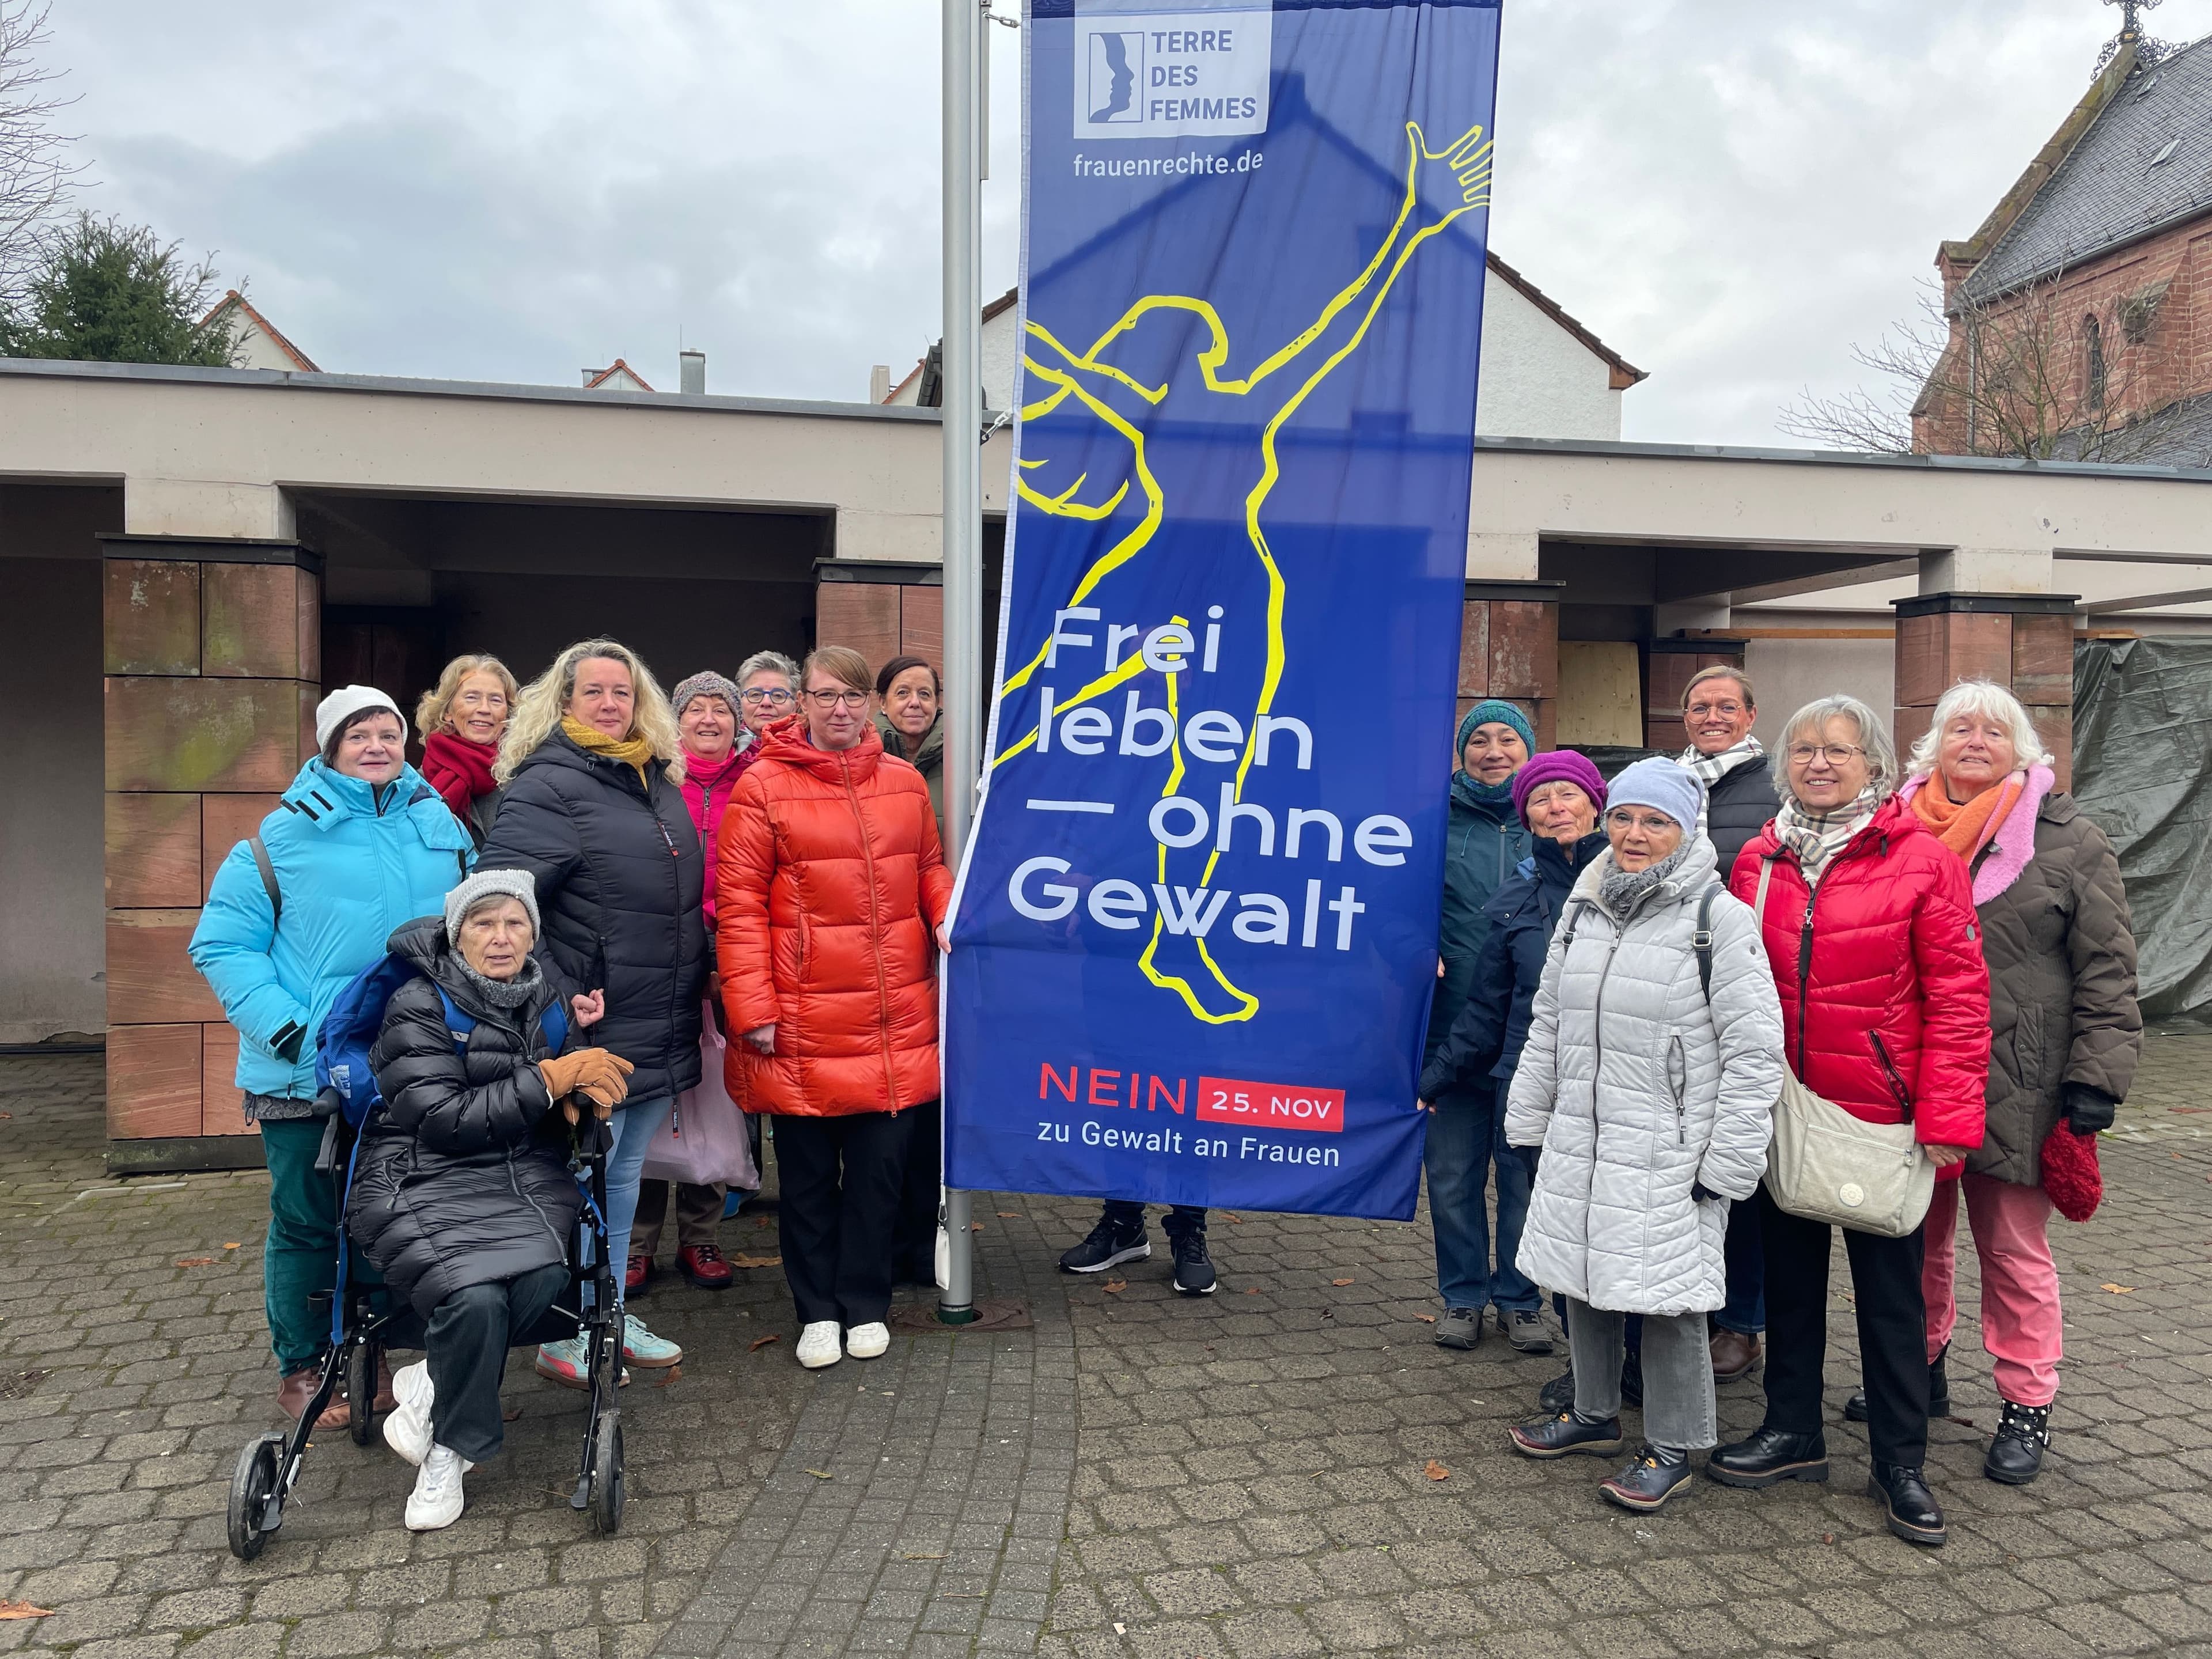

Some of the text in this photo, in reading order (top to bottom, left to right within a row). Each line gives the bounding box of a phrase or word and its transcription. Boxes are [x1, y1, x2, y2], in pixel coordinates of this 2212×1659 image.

[1151, 29, 1232, 54] TERRE
[1152, 65, 1198, 88] DES
[1150, 97, 1256, 121] FEMMES
[1073, 150, 1263, 176] frauenrechte.de
[1044, 604, 1224, 673] Frei
[1036, 687, 1313, 770] leben
[1149, 782, 1412, 866] ohne
[1008, 856, 1365, 951] Gewalt
[1039, 1063, 1187, 1115] NEIN
[1212, 1091, 1332, 1119] 25. NOV
[1037, 1121, 1339, 1167] zu Gewalt an Frauen
